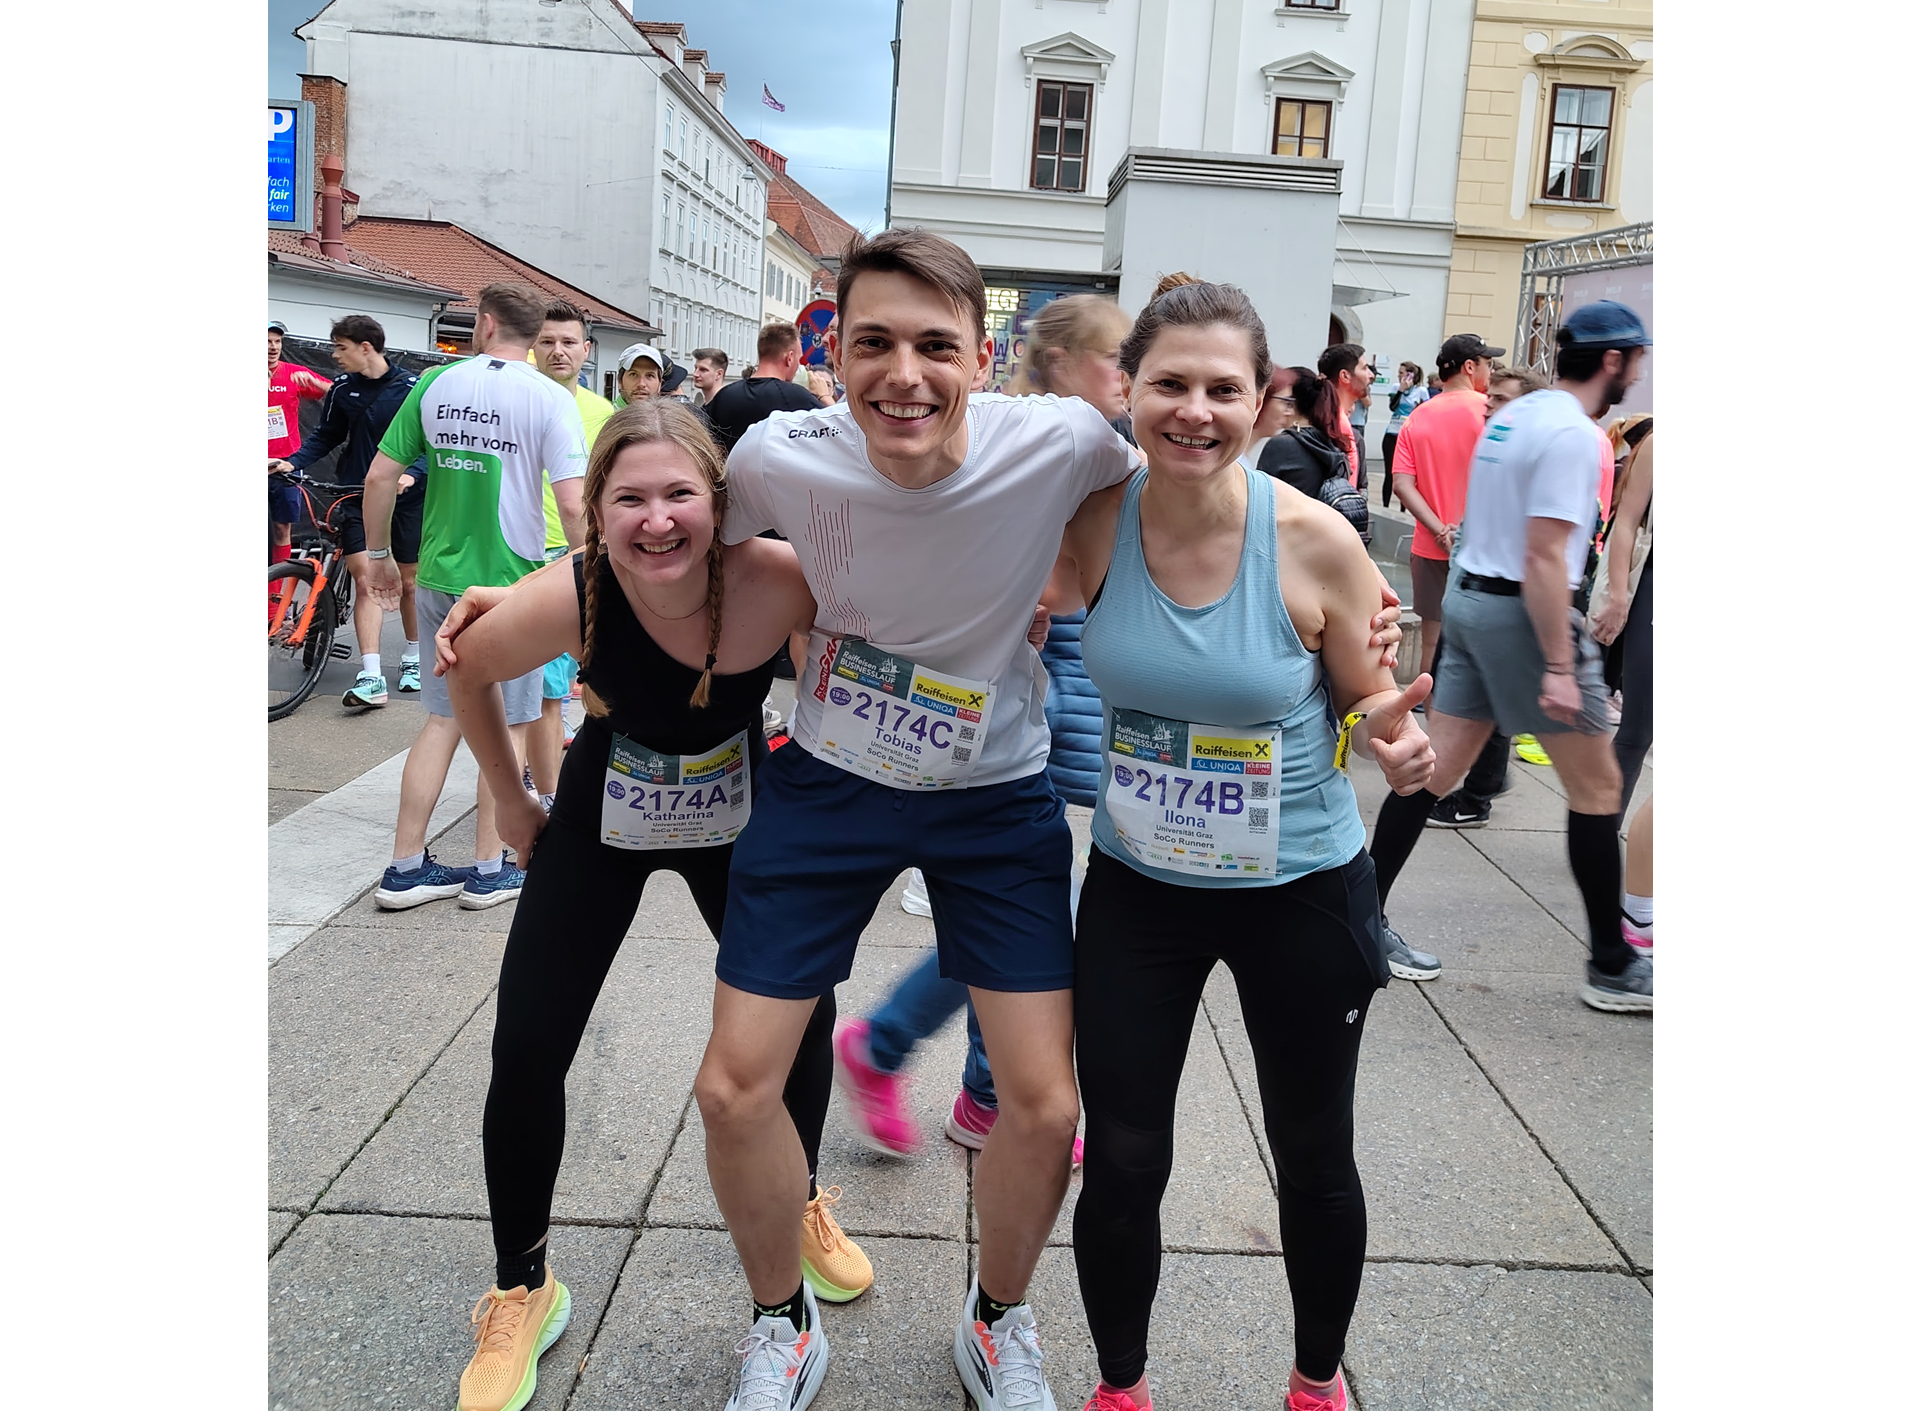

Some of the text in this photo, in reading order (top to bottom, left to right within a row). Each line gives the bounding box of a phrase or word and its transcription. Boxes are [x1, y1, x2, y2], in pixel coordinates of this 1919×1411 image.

[269, 189, 290, 201] fair
[436, 404, 500, 426] Einfach
[435, 430, 518, 454] mehr vom
[788, 427, 830, 438] CRAFT
[436, 453, 487, 474] Leben.
[843, 651, 877, 670] Raiffeisen
[840, 658, 896, 684] BUSINESSLAUF
[916, 683, 966, 705] Raiffeisen
[927, 700, 954, 714] UNIQA
[959, 709, 981, 718] KLEINE
[852, 691, 954, 750] 2174C
[875, 726, 922, 755] Tobias
[1114, 732, 1172, 752] BUSINESSLAUF
[1115, 724, 1150, 740] Raiffeisen
[615, 747, 645, 766] Raiffeisen
[867, 747, 886, 760] SoCo
[887, 756, 919, 772] Runners
[870, 741, 904, 758] Universität
[904, 755, 919, 764] Graz
[1195, 745, 1253, 758] Raiffeisen
[1340, 735, 1350, 769] Raiffeisen
[614, 754, 664, 776] BUSINESSLAUF
[686, 756, 730, 775] Raiffeisen
[1210, 762, 1241, 772] UNIQA
[700, 771, 724, 782] UNIQA
[628, 784, 728, 811] 2174A
[1134, 768, 1244, 815] 2174B
[643, 811, 714, 821] Katharina
[1165, 809, 1206, 829] Ilona
[1156, 824, 1194, 837] Universität
[1153, 833, 1176, 844] SoCo
[1178, 837, 1215, 849] Runners
